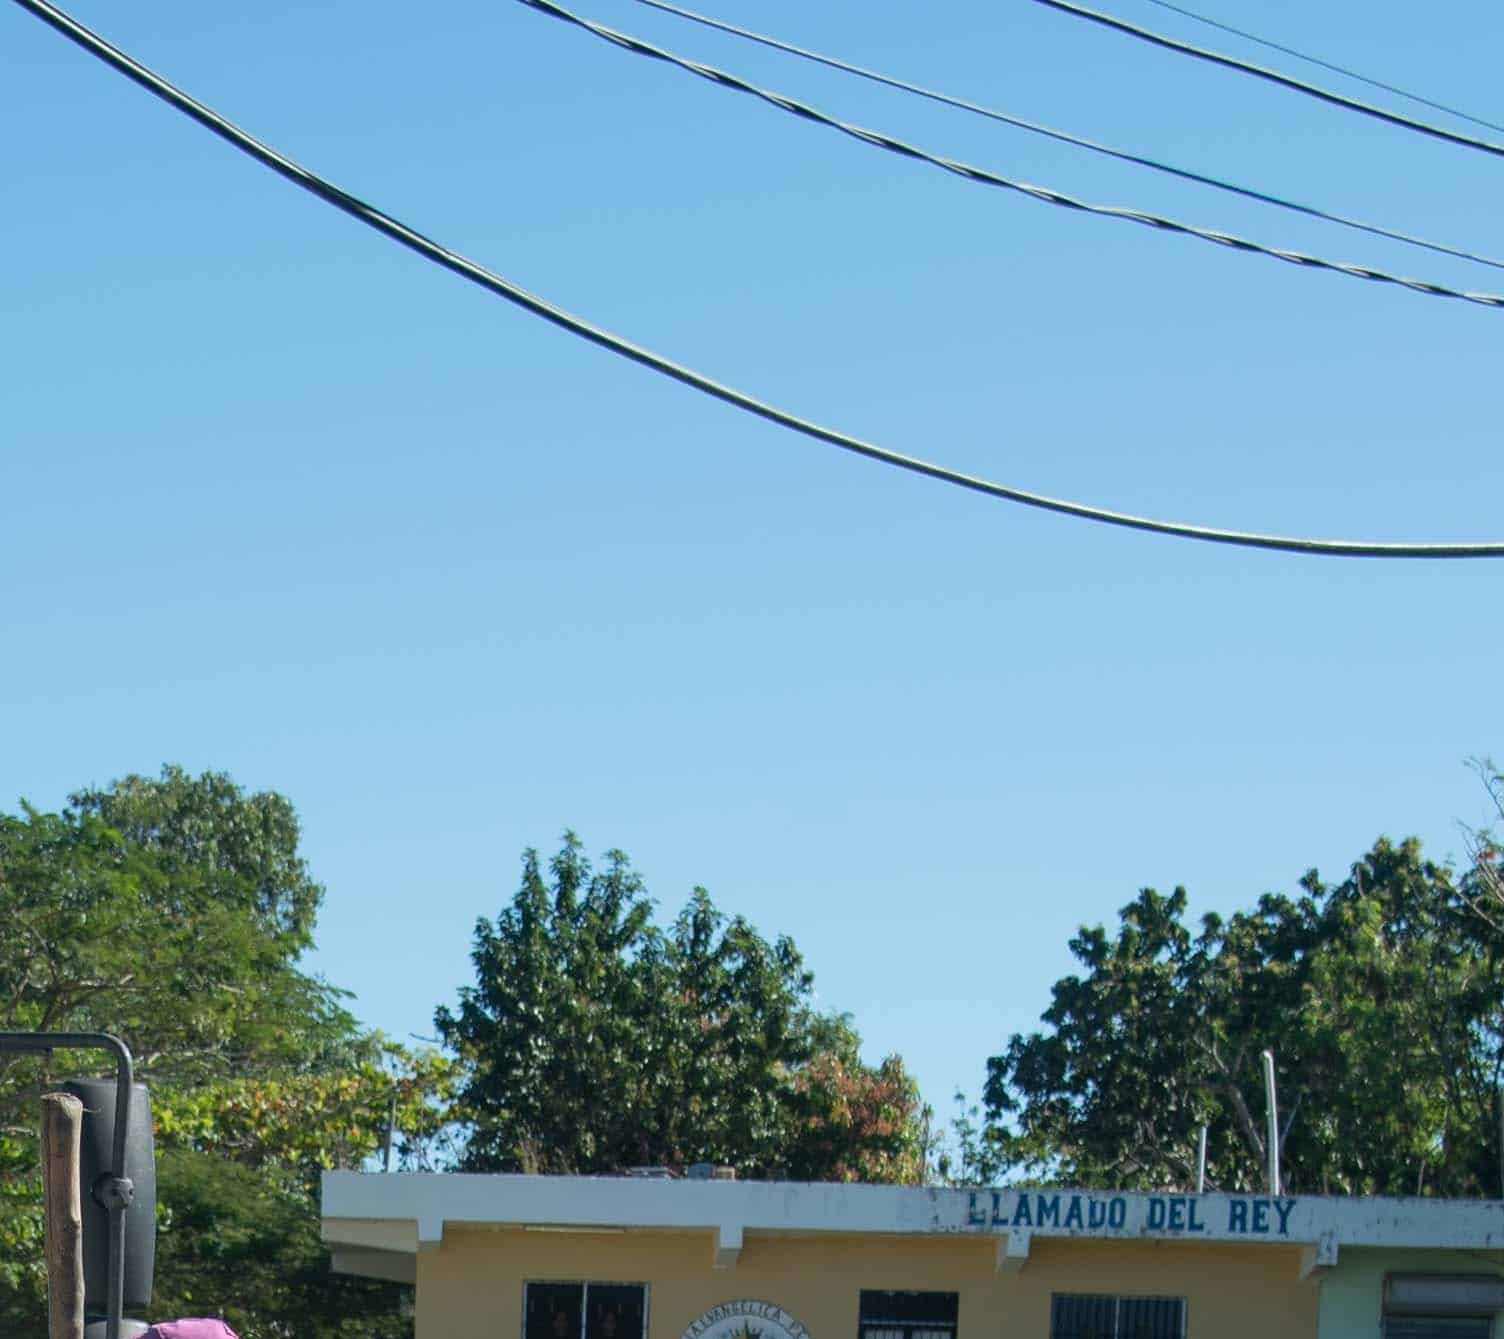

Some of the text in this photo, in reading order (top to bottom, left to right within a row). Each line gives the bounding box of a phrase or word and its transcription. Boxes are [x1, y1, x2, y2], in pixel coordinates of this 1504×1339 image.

[968, 1191, 1297, 1234] LLAMADO DEL REY
